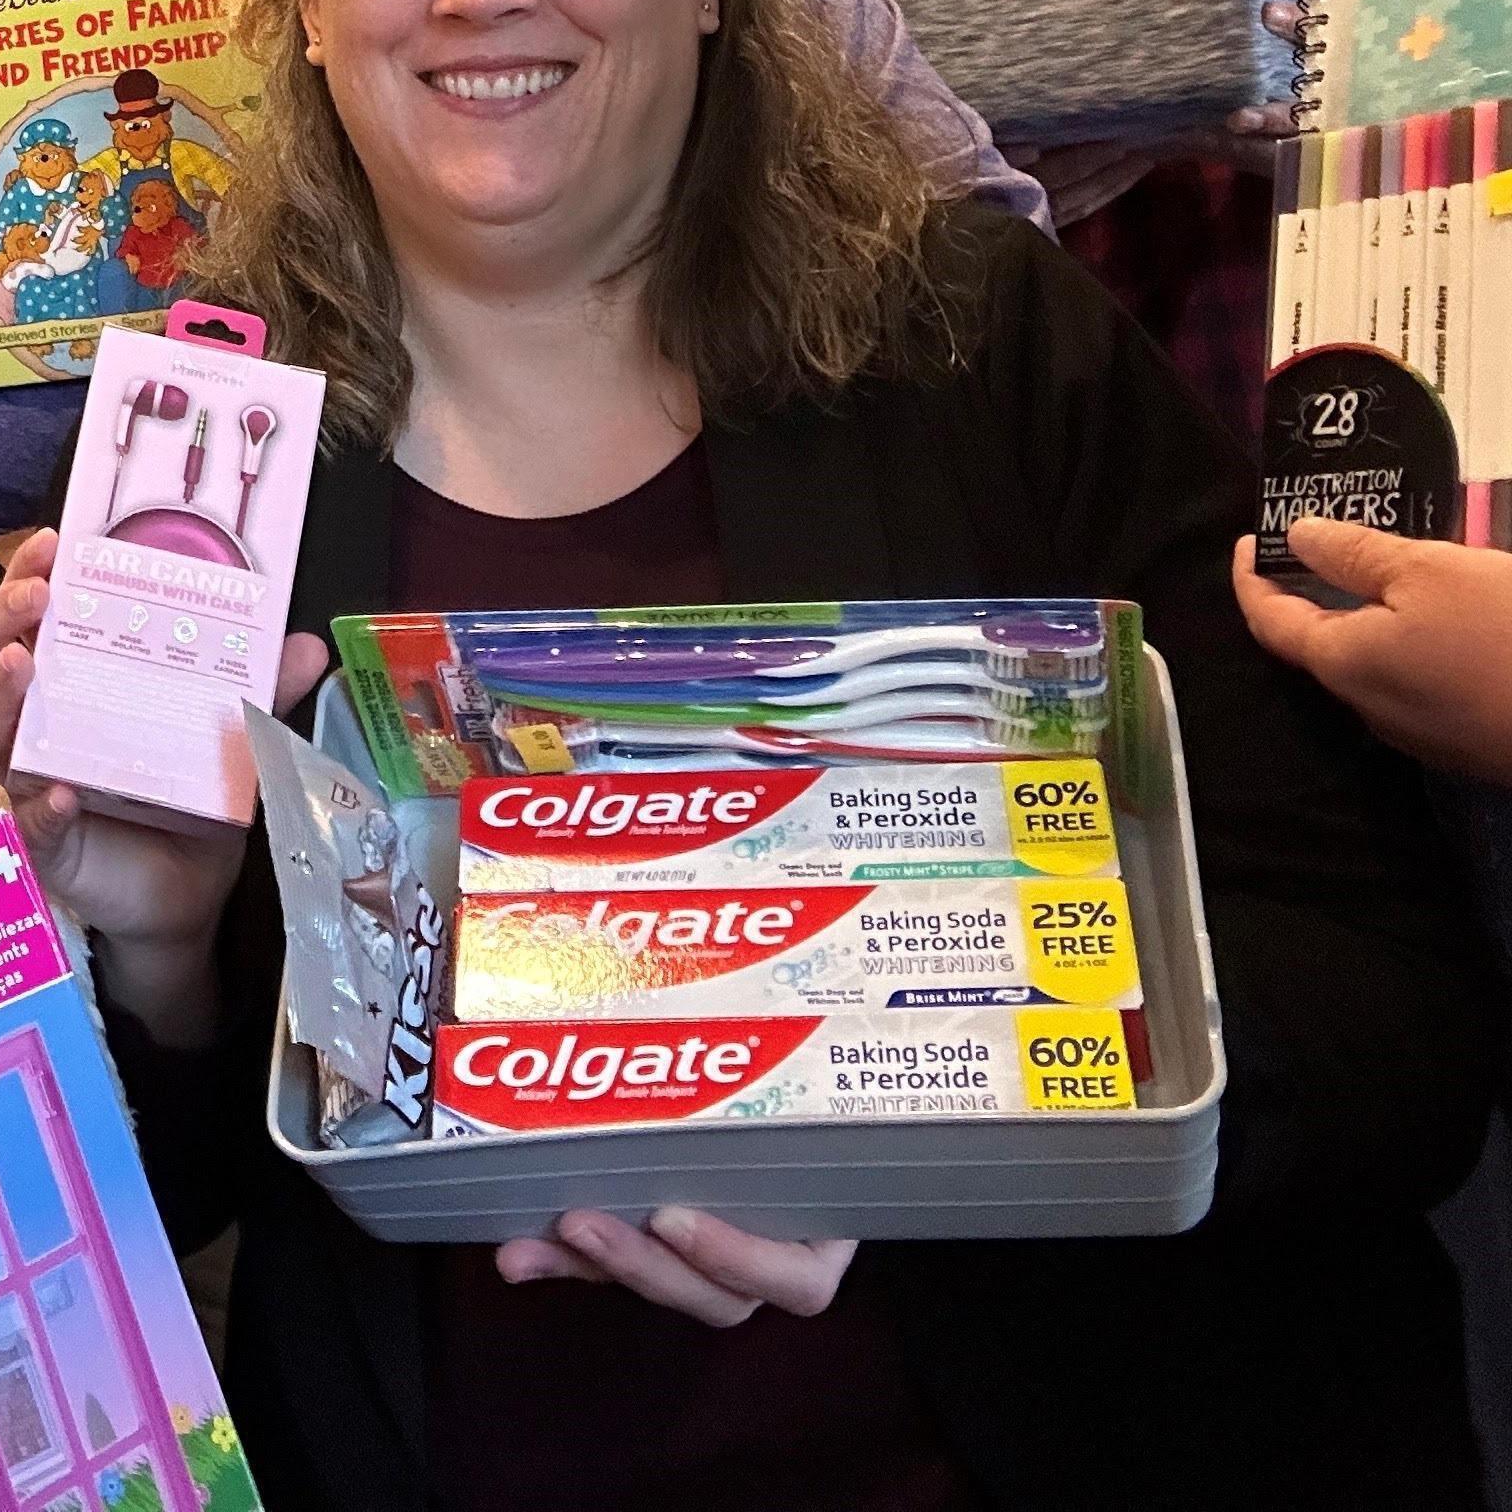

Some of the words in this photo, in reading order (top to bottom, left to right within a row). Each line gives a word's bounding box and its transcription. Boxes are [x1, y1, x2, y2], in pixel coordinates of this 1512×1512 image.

[76, 10, 115, 37] OF
[42, 30, 229, 82] FRIENDSHIP
[50, 321, 98, 339] Stories
[1311, 391, 1359, 437] 28
[1263, 467, 1404, 499] ILLUSTRATION
[1261, 491, 1402, 532] MARKERS
[73, 541, 142, 573] EAR
[148, 560, 268, 603] CANDY
[80, 566, 159, 595] EARBUDS
[162, 584, 207, 606] WITH
[209, 593, 256, 617] CASE
[829, 788, 912, 811] Baking
[917, 787, 978, 807] Soda
[1013, 780, 1100, 809] 60%
[479, 786, 758, 837] Colgate
[835, 814, 851, 829] &
[857, 808, 977, 828] Peroxide
[1025, 812, 1097, 833] FREE
[829, 830, 986, 850] WHITENING
[863, 866, 901, 878] FROSTY
[860, 910, 942, 933] Baking
[947, 908, 1007, 929] Soda
[1031, 900, 1117, 930] 25%
[866, 937, 882, 953] &
[888, 930, 1006, 952] Peroxide
[1042, 934, 1116, 956] FREE
[859, 954, 1015, 975] WHITENING
[905, 991, 946, 1005] BRISK
[829, 1040, 917, 1069] Baking
[923, 1038, 990, 1064] Soda
[1029, 1035, 1121, 1068] 60%
[452, 1034, 751, 1101] Colgate
[836, 1073, 853, 1090] &
[859, 1065, 989, 1090] Peroxide
[1042, 1075, 1119, 1099] FREE
[828, 1094, 999, 1113] WHITENING
